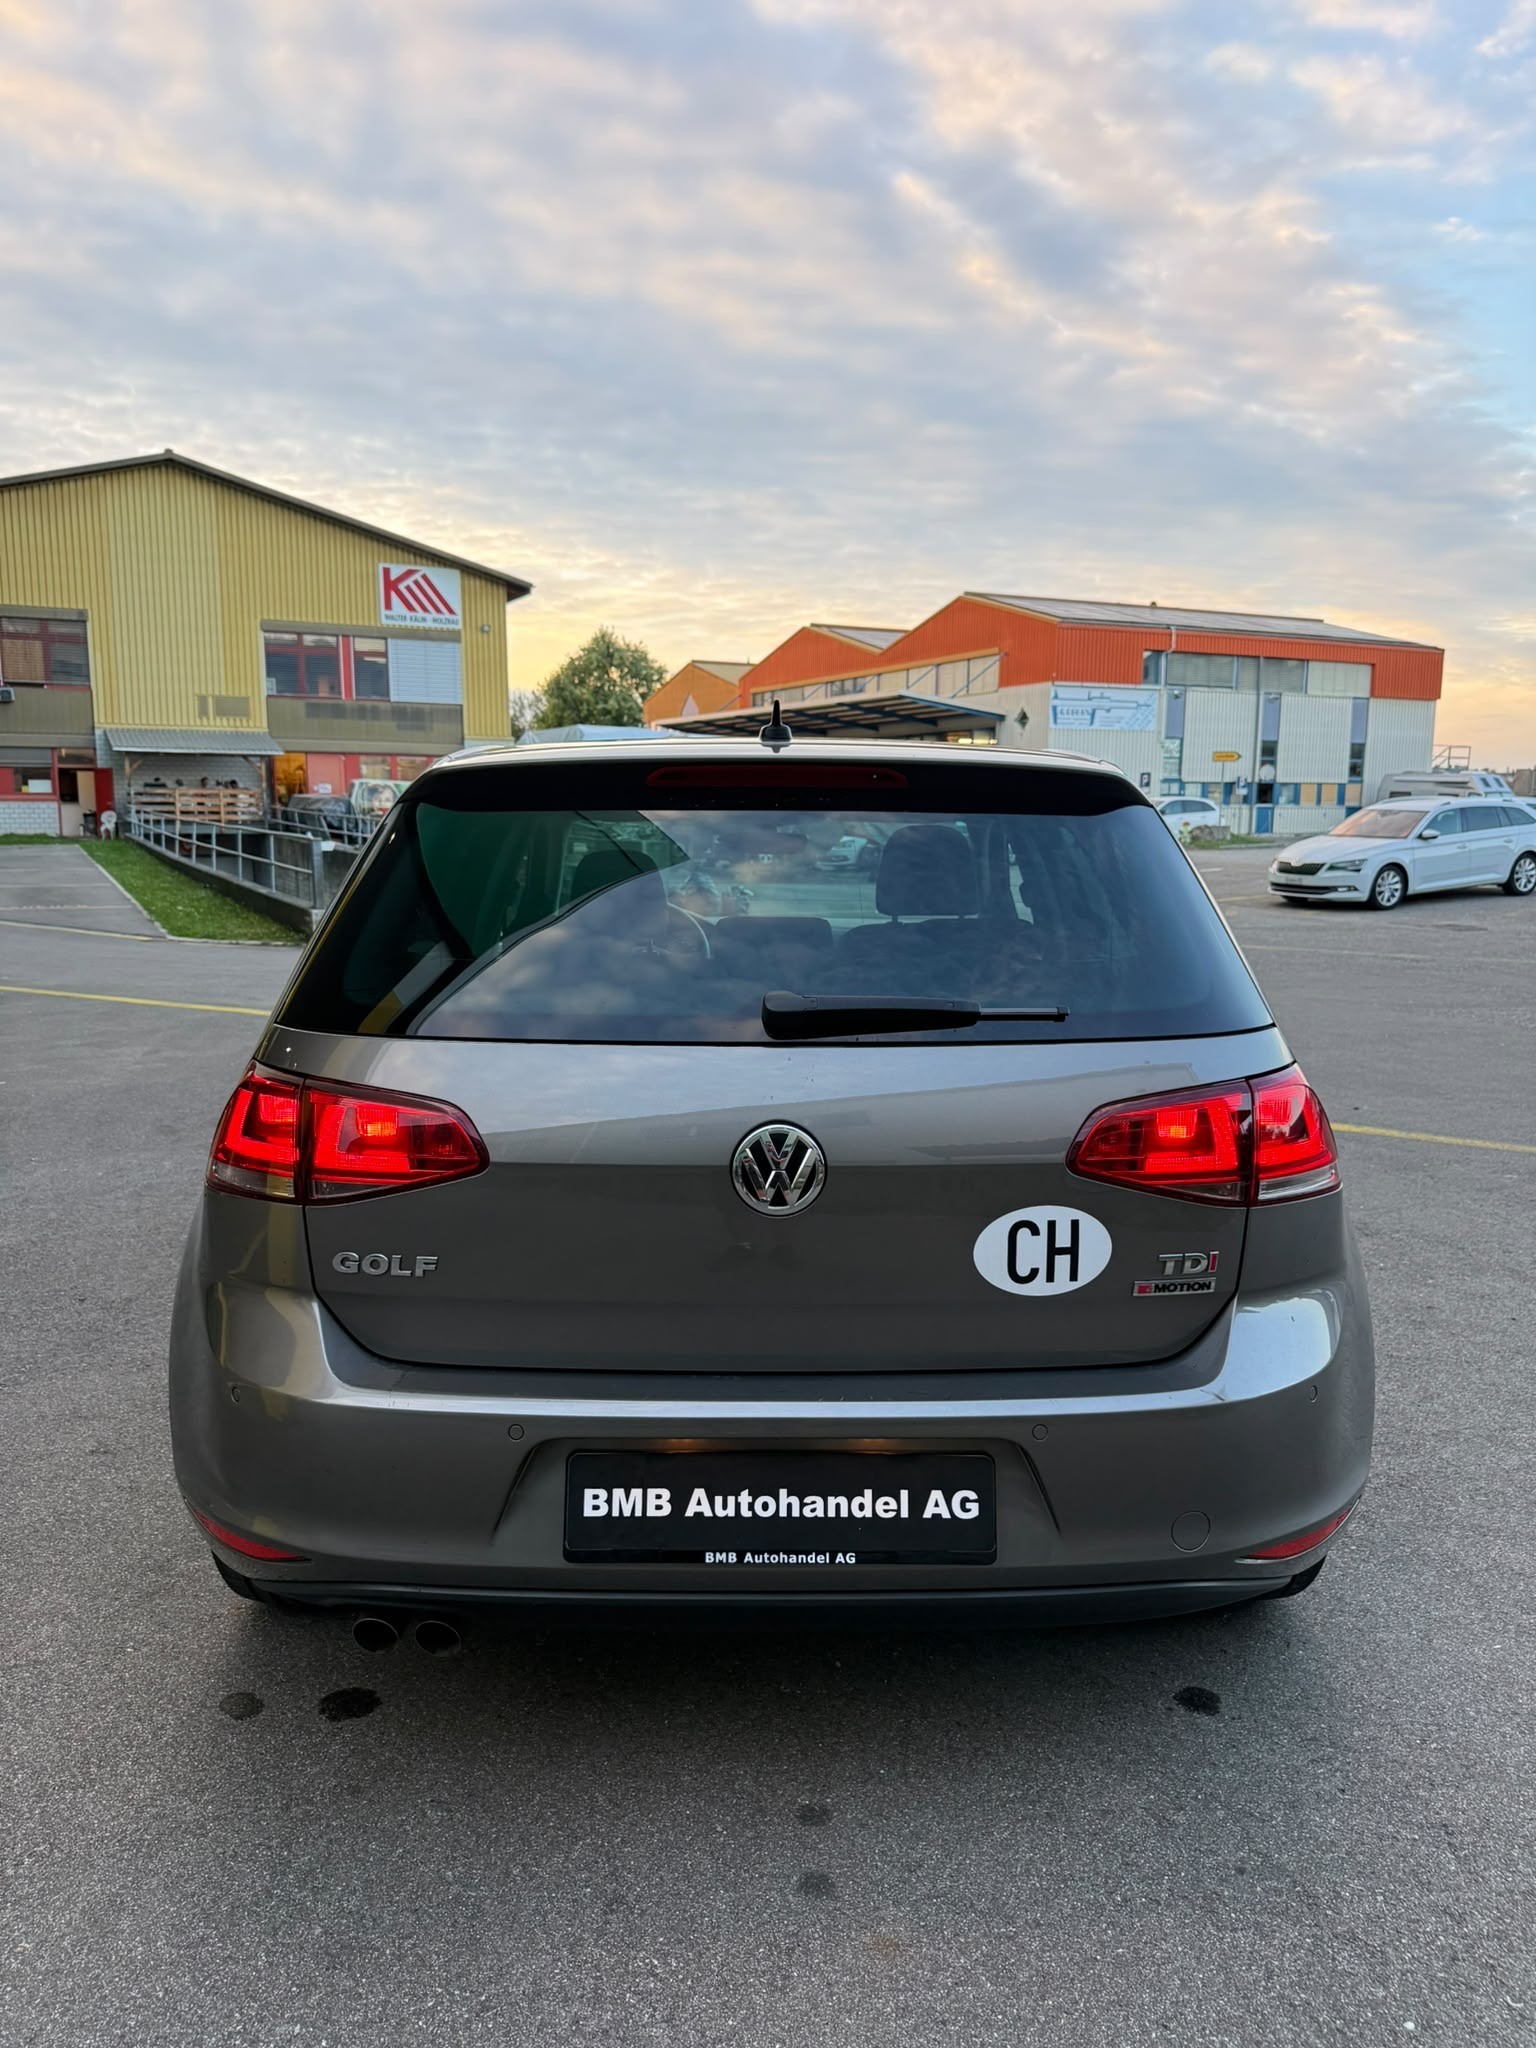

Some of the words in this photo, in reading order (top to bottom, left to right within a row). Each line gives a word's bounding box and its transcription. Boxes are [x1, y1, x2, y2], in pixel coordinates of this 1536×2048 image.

[384, 613, 407, 622] WALTER
[736, 1125, 824, 1212] VW
[1007, 1218, 1080, 1285] CH
[1159, 1250, 1219, 1276] TDI
[332, 1252, 438, 1278] GOLF
[583, 1487, 672, 1518] BMB
[685, 1487, 908, 1519] Autohandel
[922, 1489, 980, 1520] AG
[705, 1552, 737, 1564] BMB
[743, 1552, 830, 1564] Autohandel
[835, 1552, 856, 1564] AG
